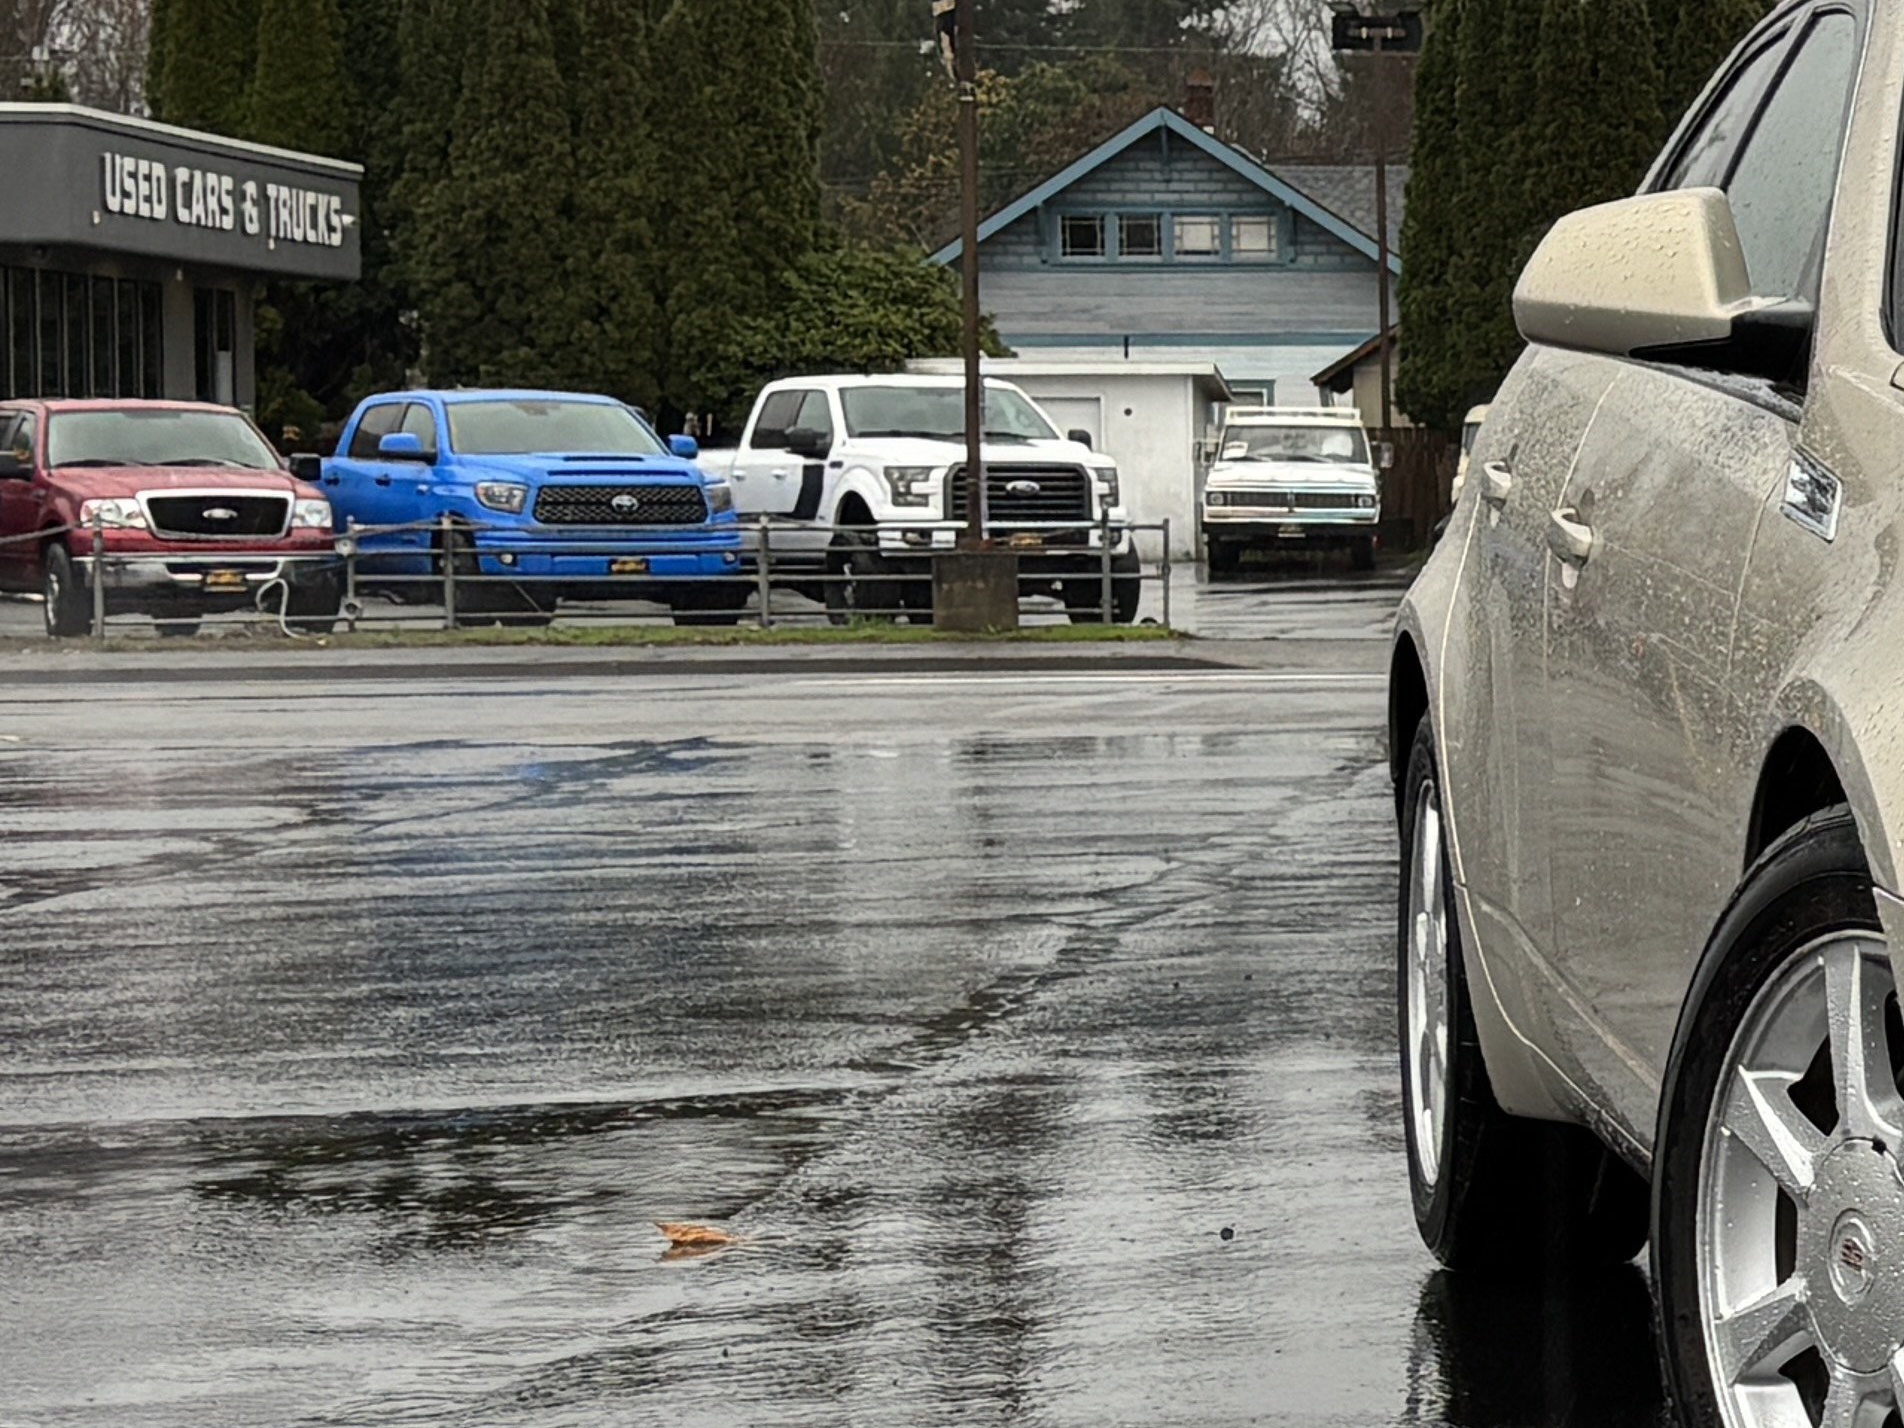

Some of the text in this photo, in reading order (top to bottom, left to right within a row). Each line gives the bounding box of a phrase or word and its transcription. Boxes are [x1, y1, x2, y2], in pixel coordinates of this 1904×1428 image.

[104, 152, 342, 247] USED CARS & TRUCKS
